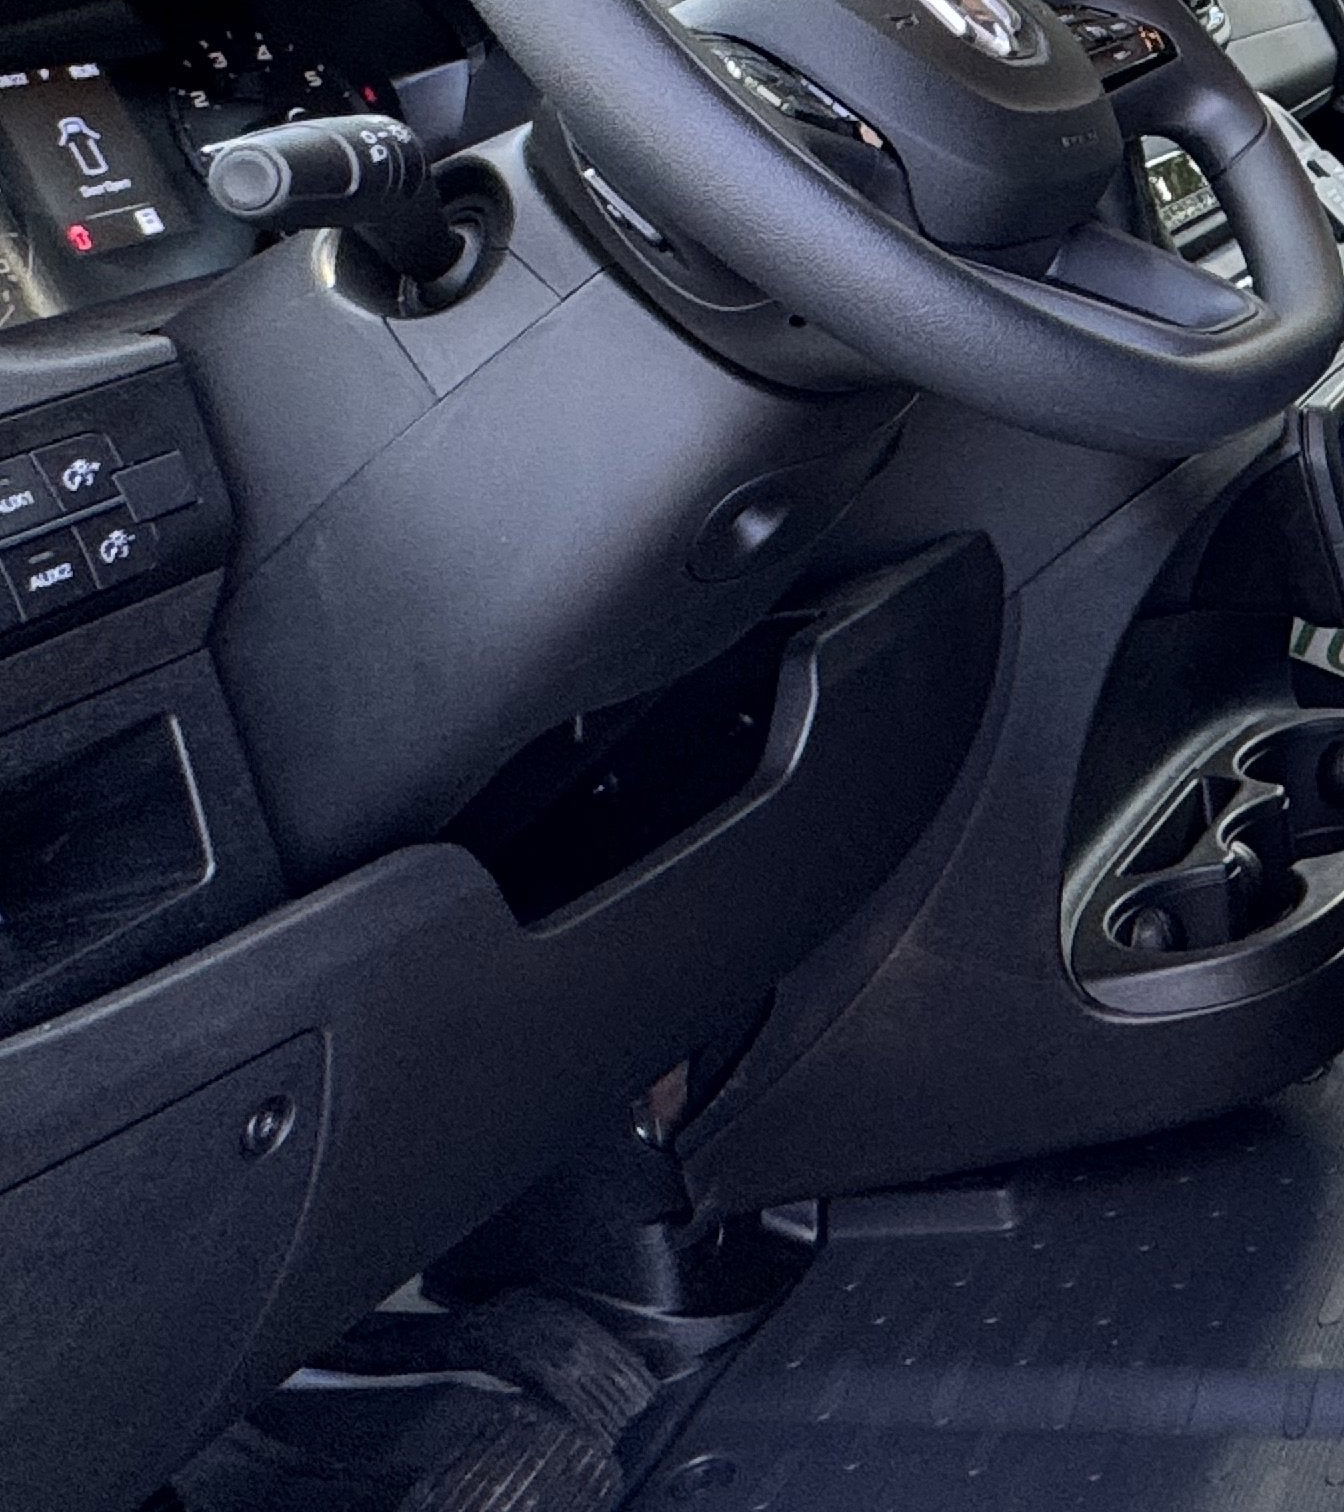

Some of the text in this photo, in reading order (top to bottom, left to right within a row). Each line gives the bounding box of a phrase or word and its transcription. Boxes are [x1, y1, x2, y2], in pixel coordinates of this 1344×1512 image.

[208, 51, 228, 69] 3
[256, 44, 273, 61] 4
[304, 70, 323, 87] 5
[190, 90, 210, 108] 2
[0, 490, 35, 514] UX1
[28, 562, 74, 592] AUX2
